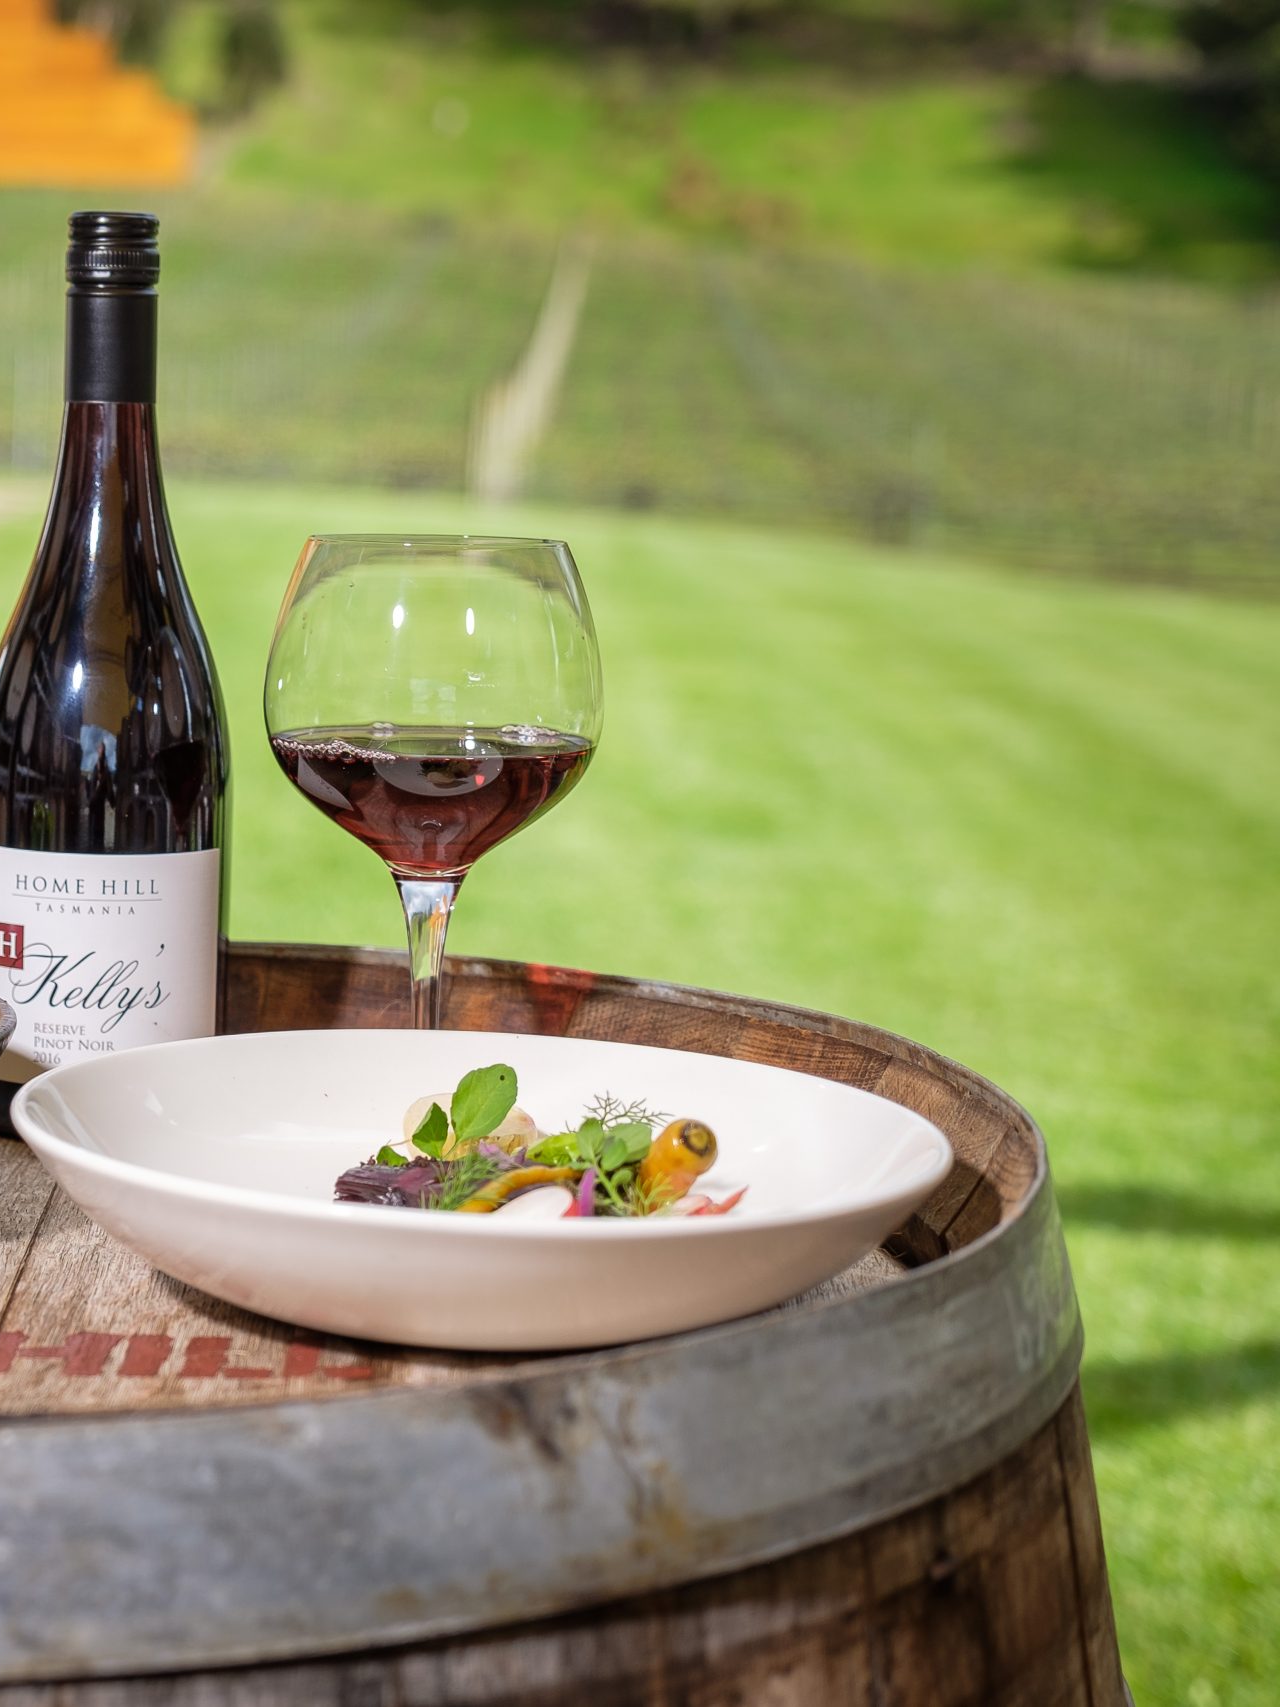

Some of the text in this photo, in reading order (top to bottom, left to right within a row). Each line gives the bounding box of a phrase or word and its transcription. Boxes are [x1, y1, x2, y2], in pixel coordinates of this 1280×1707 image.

[16, 873, 160, 896] HOME HILL
[35, 902, 137, 915] TASMANIA
[8, 942, 171, 1034] Kelly's
[33, 1022, 86, 1036] RESERVE
[33, 1036, 115, 1052] PINOT NOIR
[32, 1051, 62, 1065] 2016
